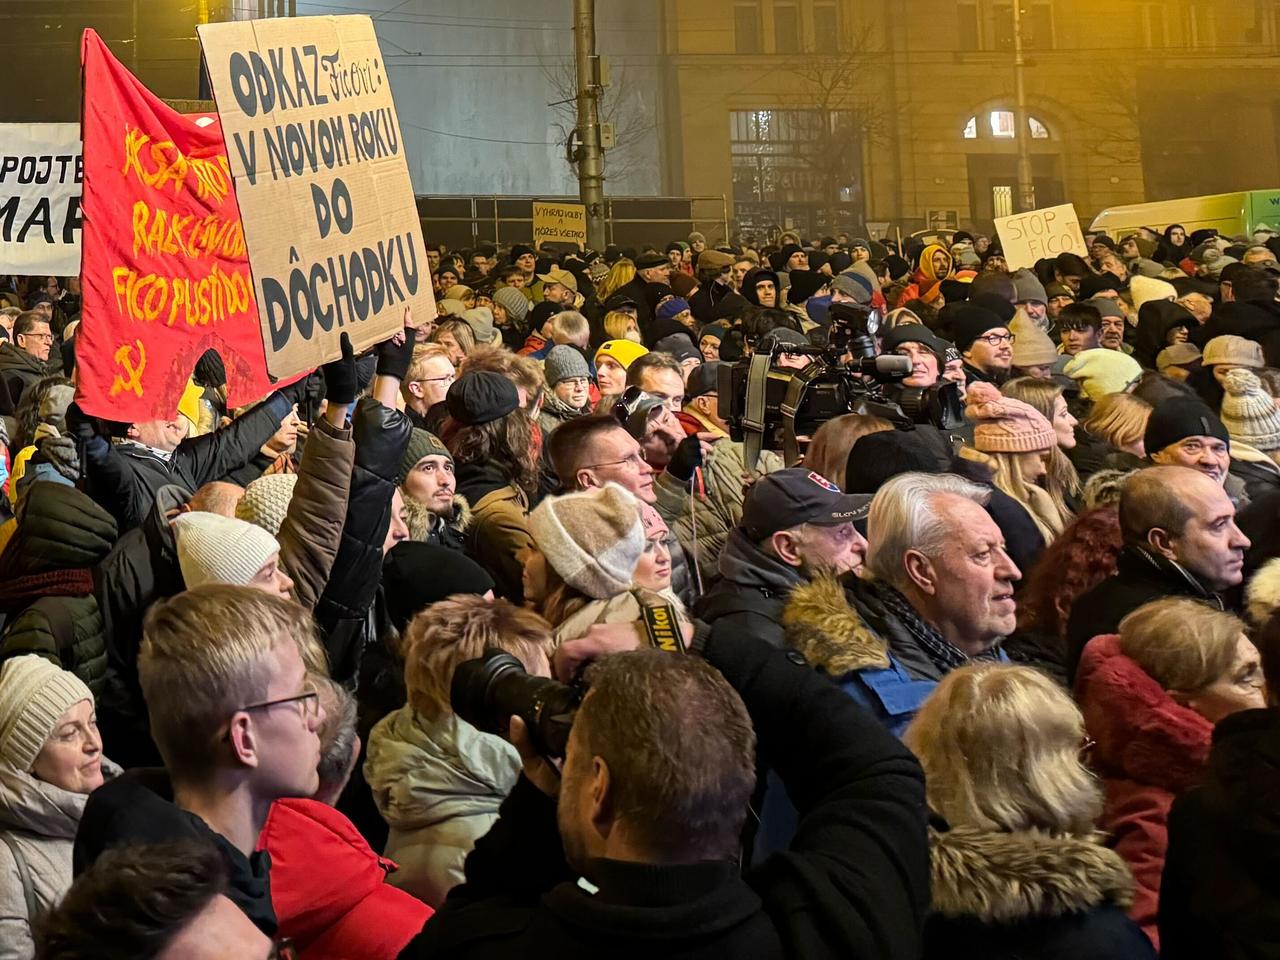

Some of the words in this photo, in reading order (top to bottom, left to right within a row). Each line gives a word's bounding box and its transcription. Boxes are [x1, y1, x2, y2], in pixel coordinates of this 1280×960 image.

[229, 44, 329, 118] ODKAZ
[233, 130, 256, 185] V
[263, 115, 350, 181] NOVOM
[349, 107, 398, 163] ROKU
[310, 177, 353, 239] DO
[1006, 211, 1056, 241] STOP
[261, 232, 419, 352] DÔCHODKU
